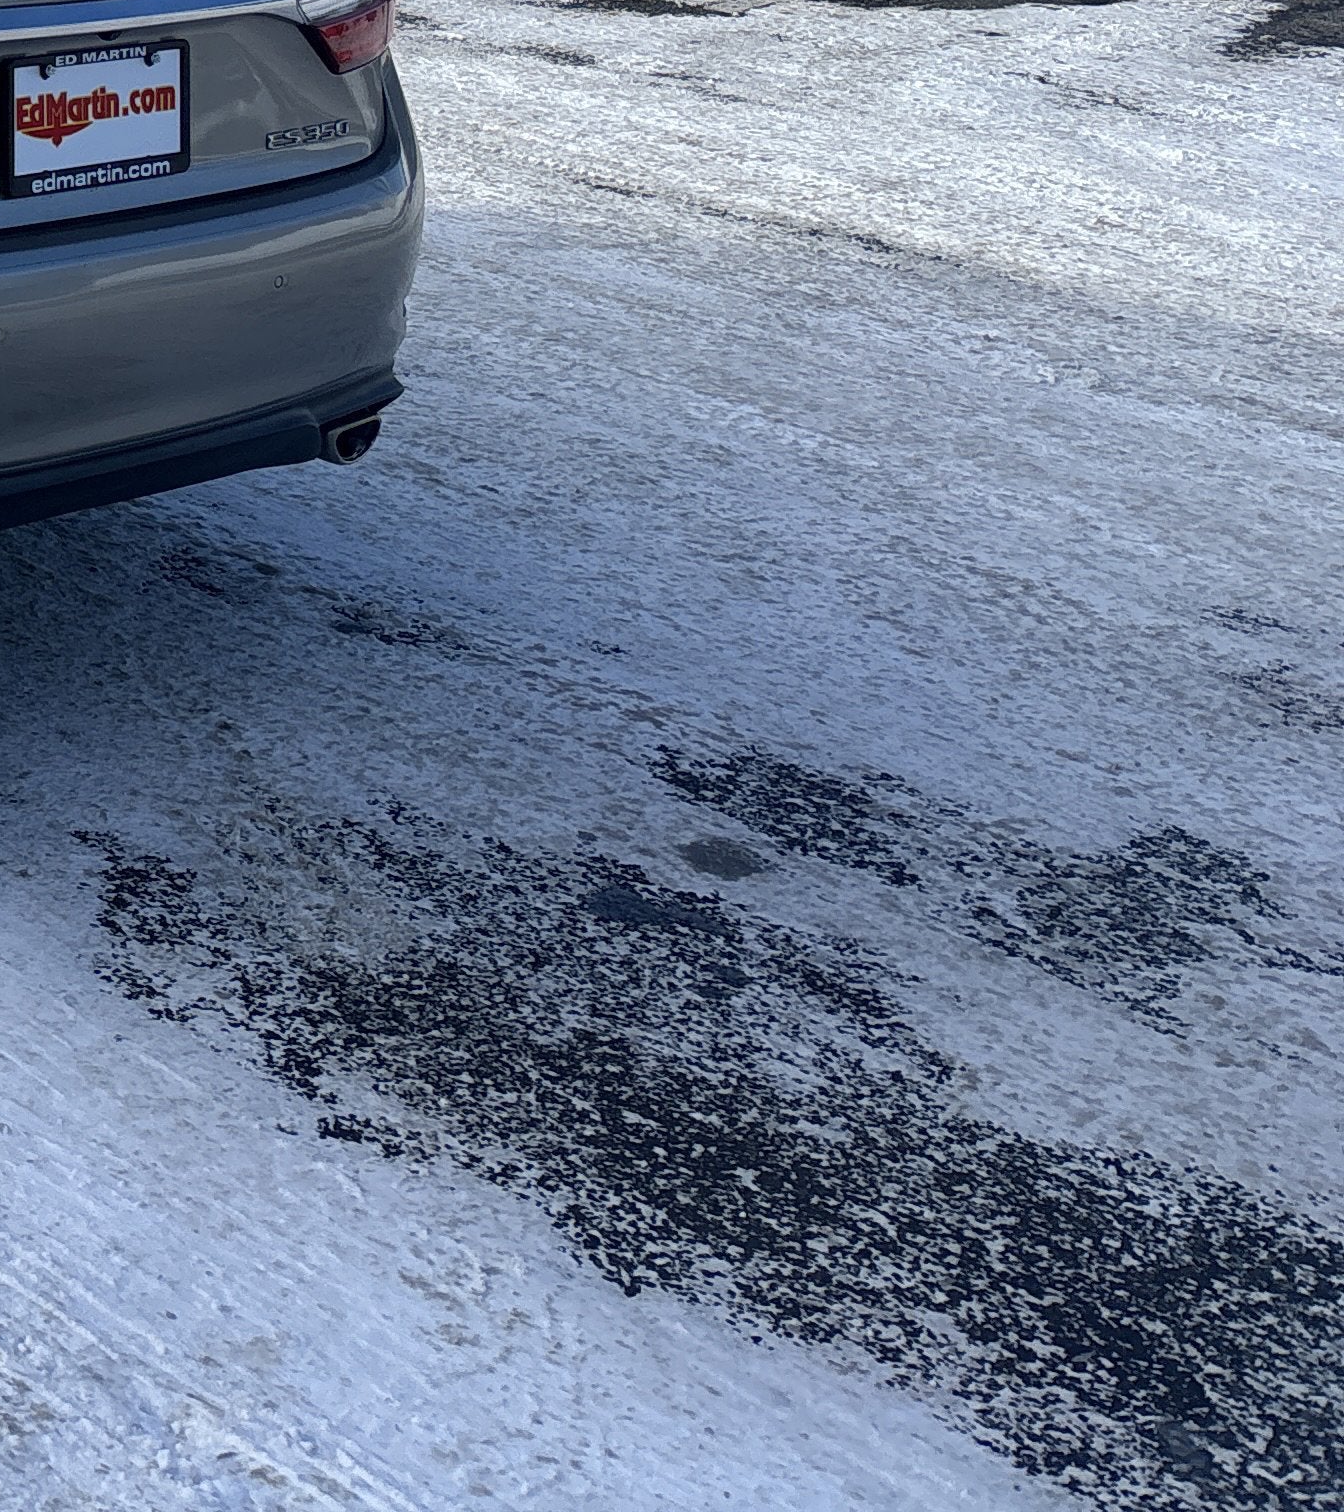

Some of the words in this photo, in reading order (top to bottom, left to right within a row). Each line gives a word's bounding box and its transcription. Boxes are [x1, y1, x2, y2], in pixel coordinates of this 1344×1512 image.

[55, 54, 78, 67] ED
[82, 46, 148, 64] MARTIN
[15, 85, 177, 132] EdMartin.com
[266, 127, 303, 150] ES
[302, 117, 351, 144] 350
[31, 159, 171, 194] edmartin.com
